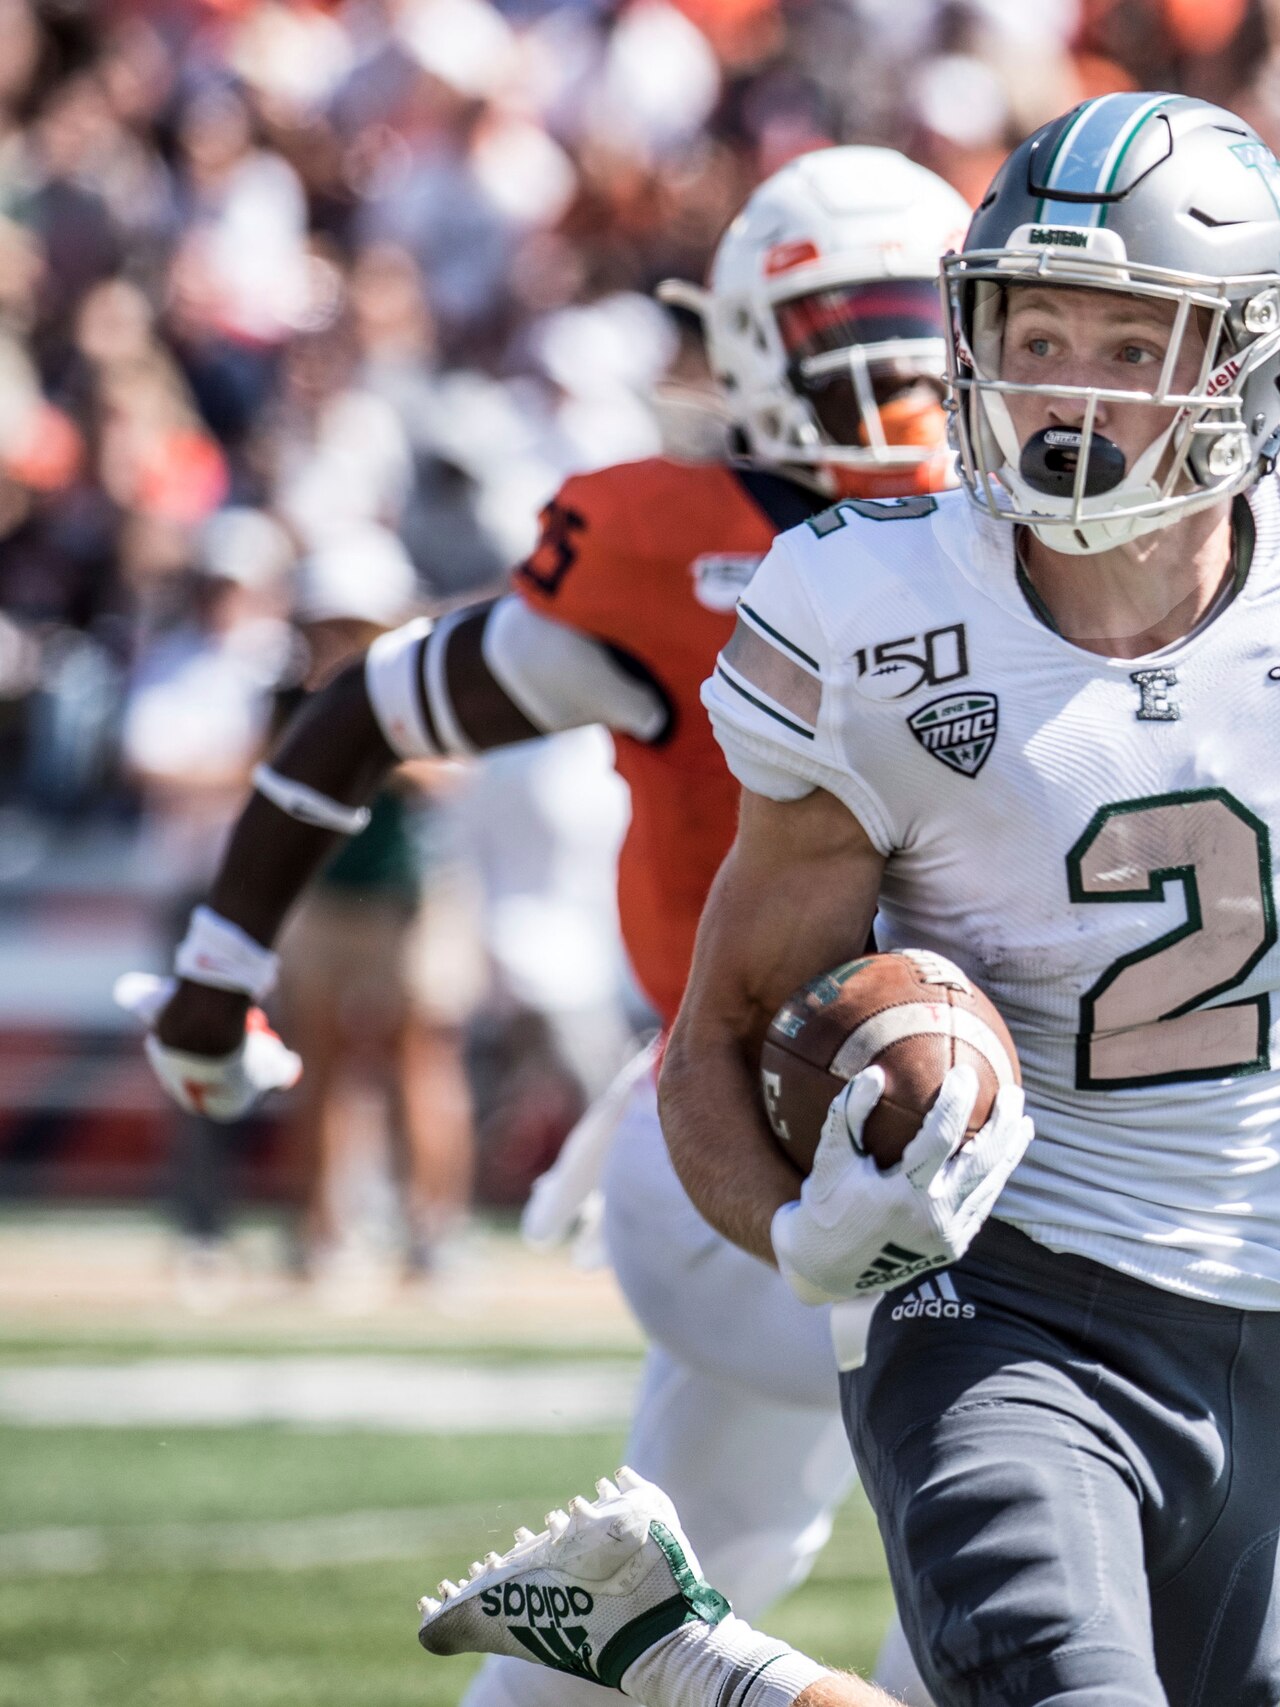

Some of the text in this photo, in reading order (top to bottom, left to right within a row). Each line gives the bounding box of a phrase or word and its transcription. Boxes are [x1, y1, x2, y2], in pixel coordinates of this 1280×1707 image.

[1029, 228, 1088, 248] EASTERN
[852, 623, 969, 699] 150
[1130, 668, 1181, 721] E
[920, 712, 995, 750] MAC
[1066, 787, 1278, 1090] 2
[855, 1254, 948, 1290] adidas
[891, 1298, 976, 1321] adidas
[480, 1583, 594, 1628] adidas
